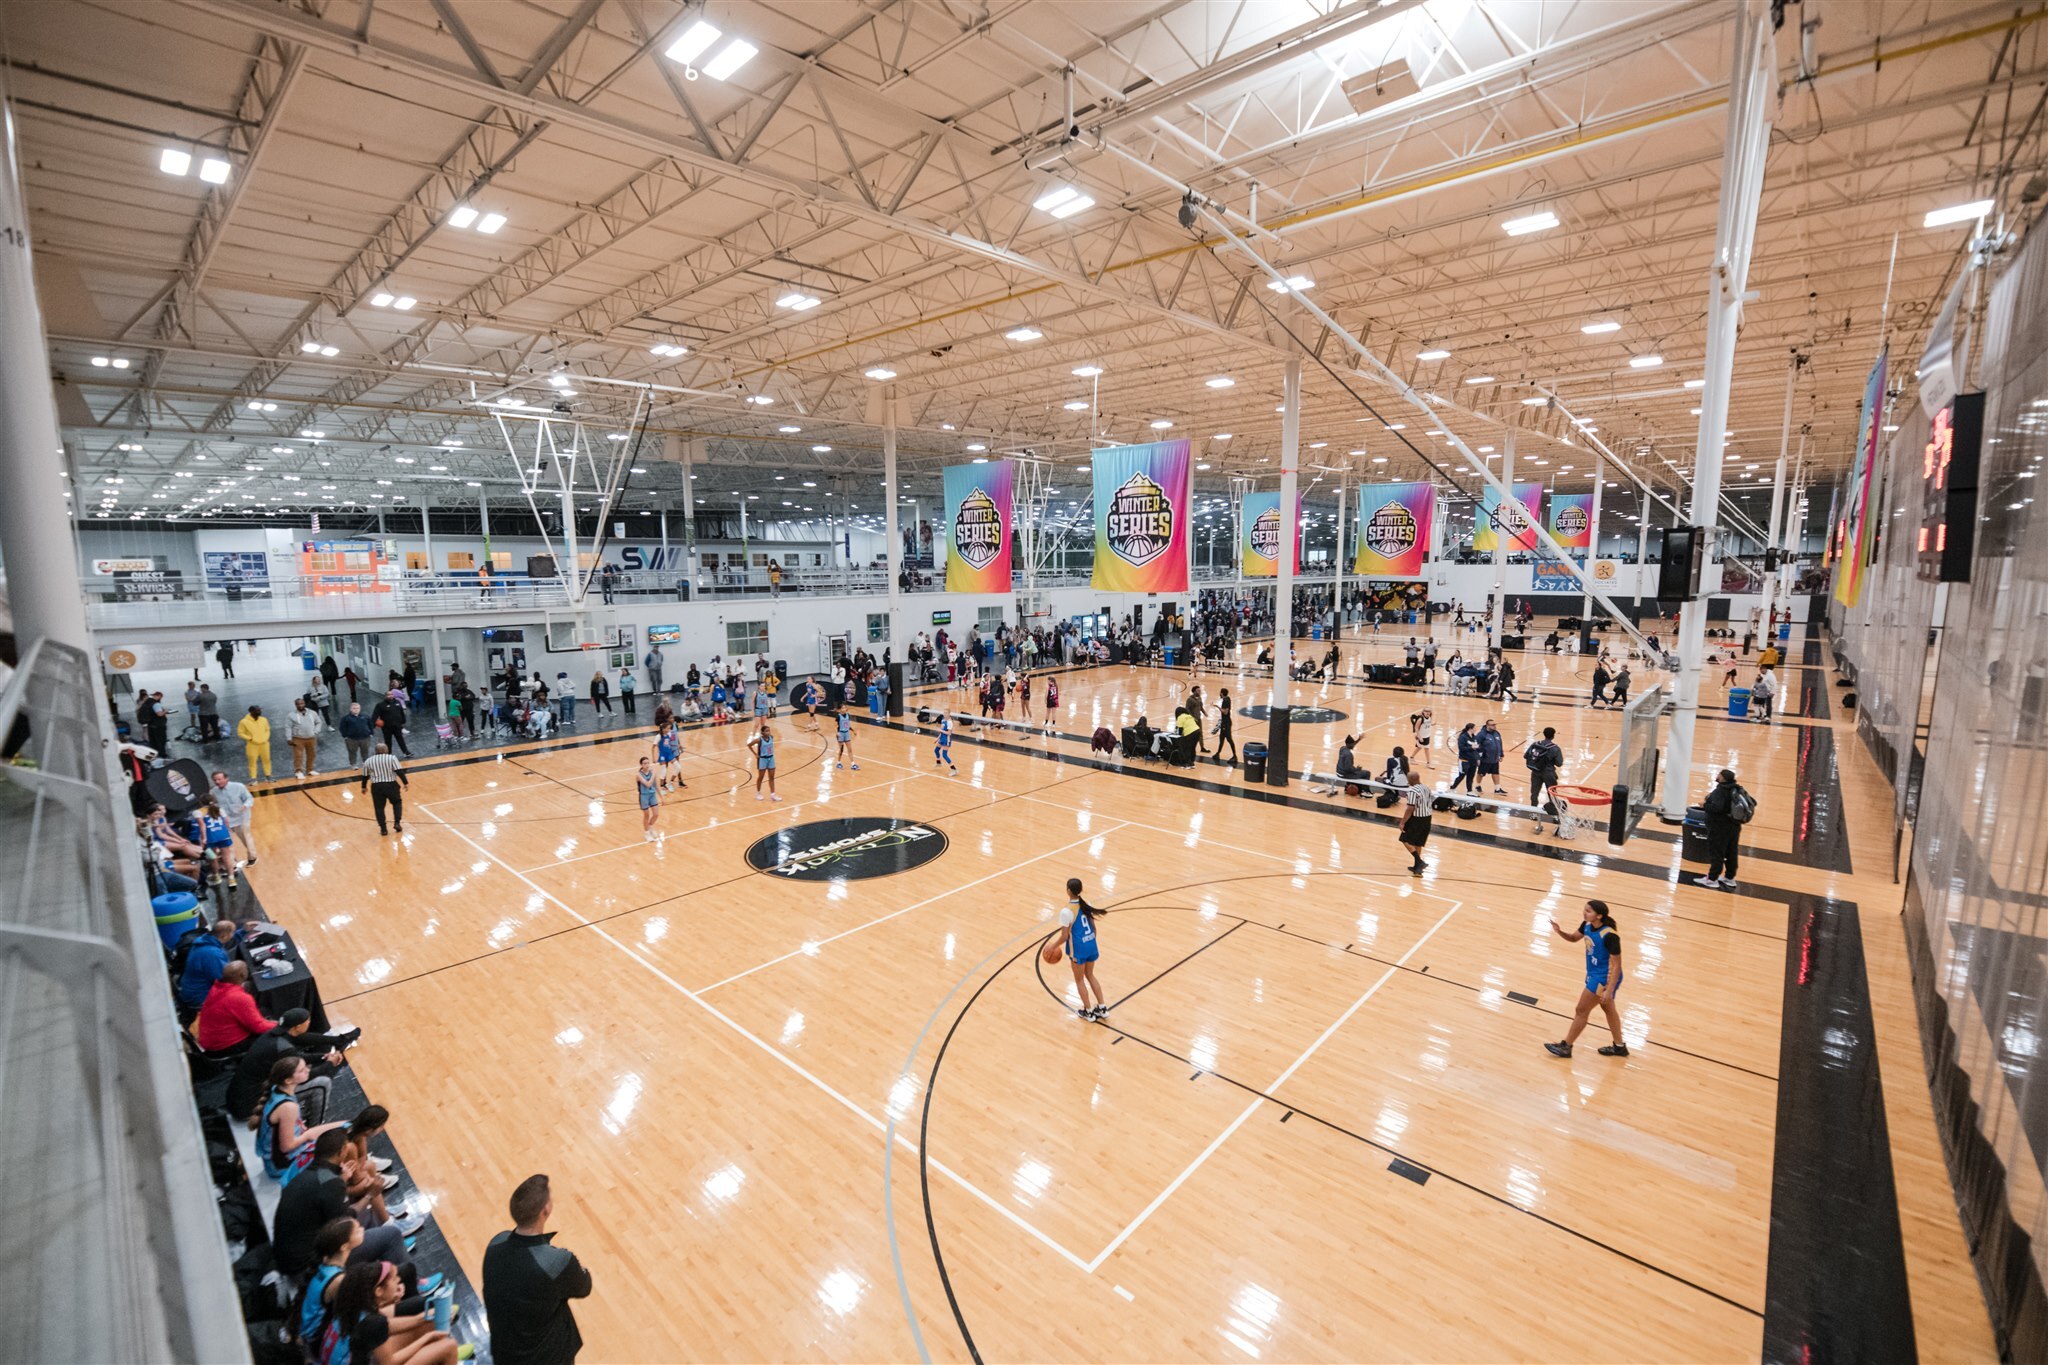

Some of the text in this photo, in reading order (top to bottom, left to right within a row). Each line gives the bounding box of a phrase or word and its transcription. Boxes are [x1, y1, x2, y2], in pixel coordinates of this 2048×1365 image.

[1118, 496, 1160, 513] WINTER
[963, 509, 993, 522] WINTER
[1376, 515, 1408, 525] WINTER
[1109, 512, 1170, 538] SERIES
[1258, 521, 1280, 530] WINTE
[1557, 519, 1586, 528] SERIES
[956, 523, 1000, 544] SERIES
[1368, 525, 1414, 541] SERIES
[130, 571, 165, 582] GUEST
[123, 583, 175, 593] SERVICES
[788, 828, 888, 861] SPORTS
[1081, 914, 1092, 935] 9
